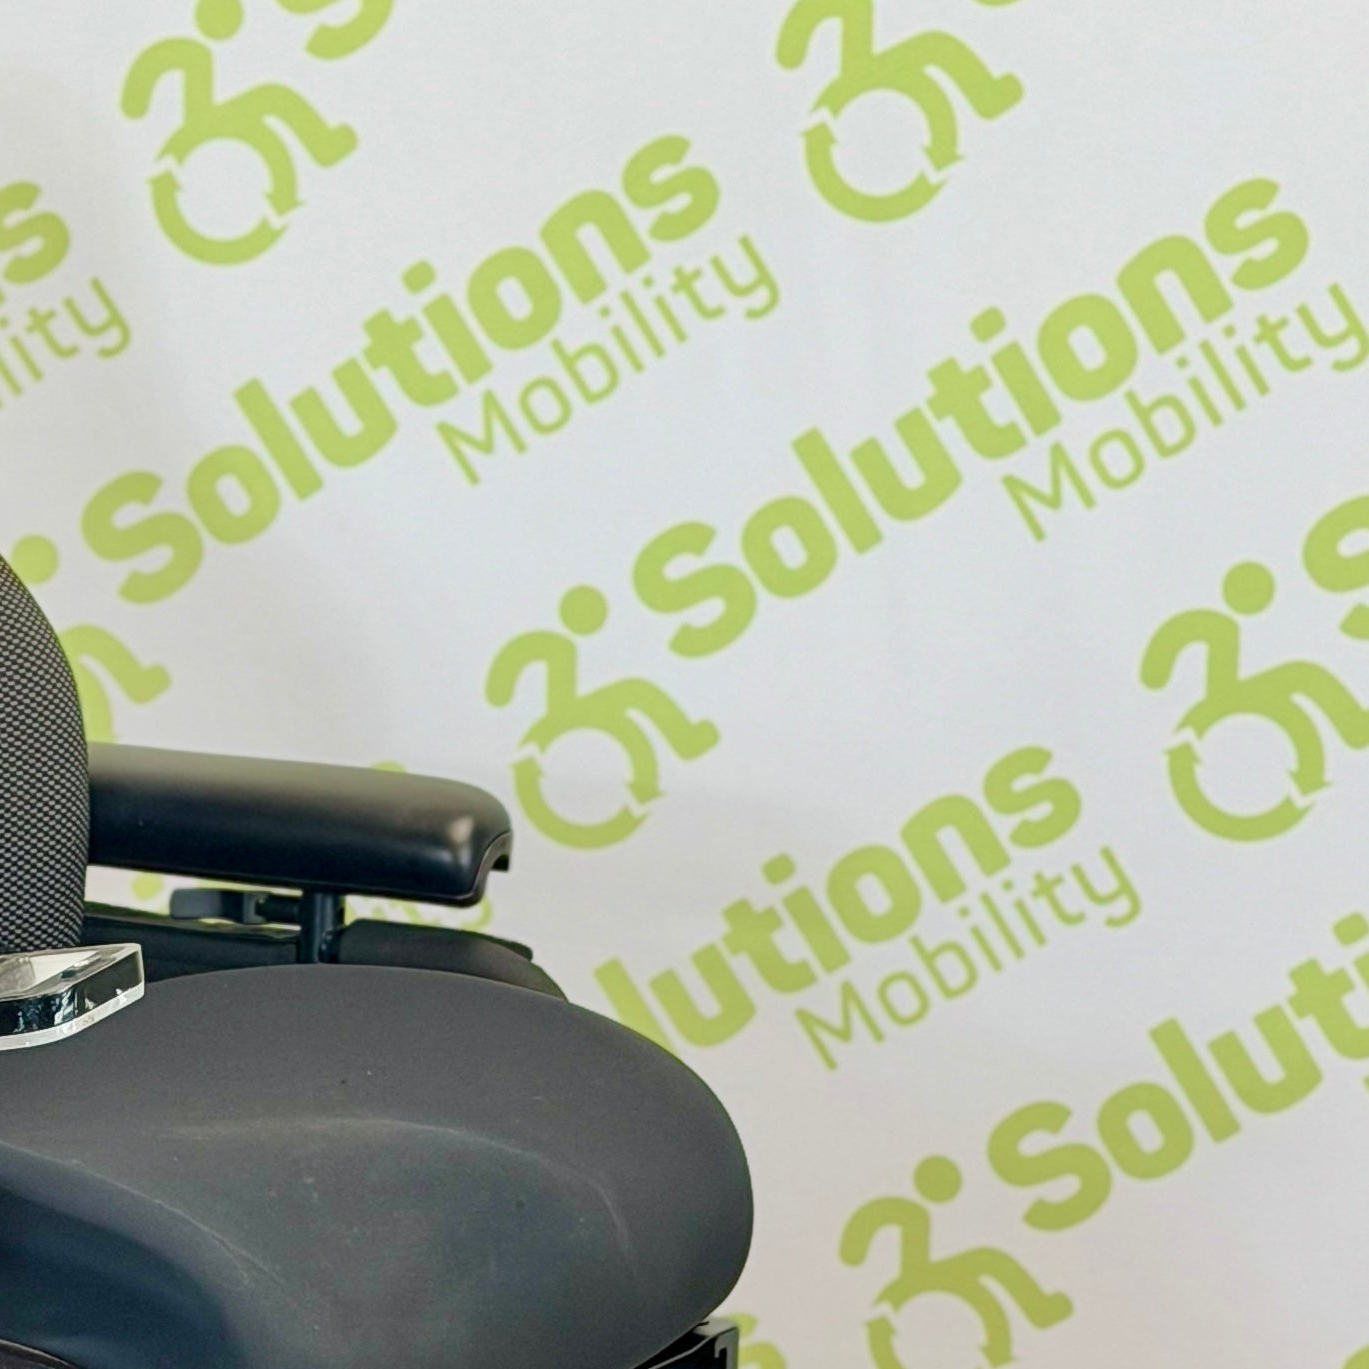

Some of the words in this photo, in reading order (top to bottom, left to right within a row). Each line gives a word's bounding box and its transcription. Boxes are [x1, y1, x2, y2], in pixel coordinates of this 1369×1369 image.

[81, 134, 721, 606] Solutions
[434, 234, 781, 487] Mobility
[631, 177, 1311, 659] Solutions
[1001, 283, 1369, 543] Mobility
[593, 745, 1083, 1060] lutions
[793, 846, 1143, 1070] Mobility
